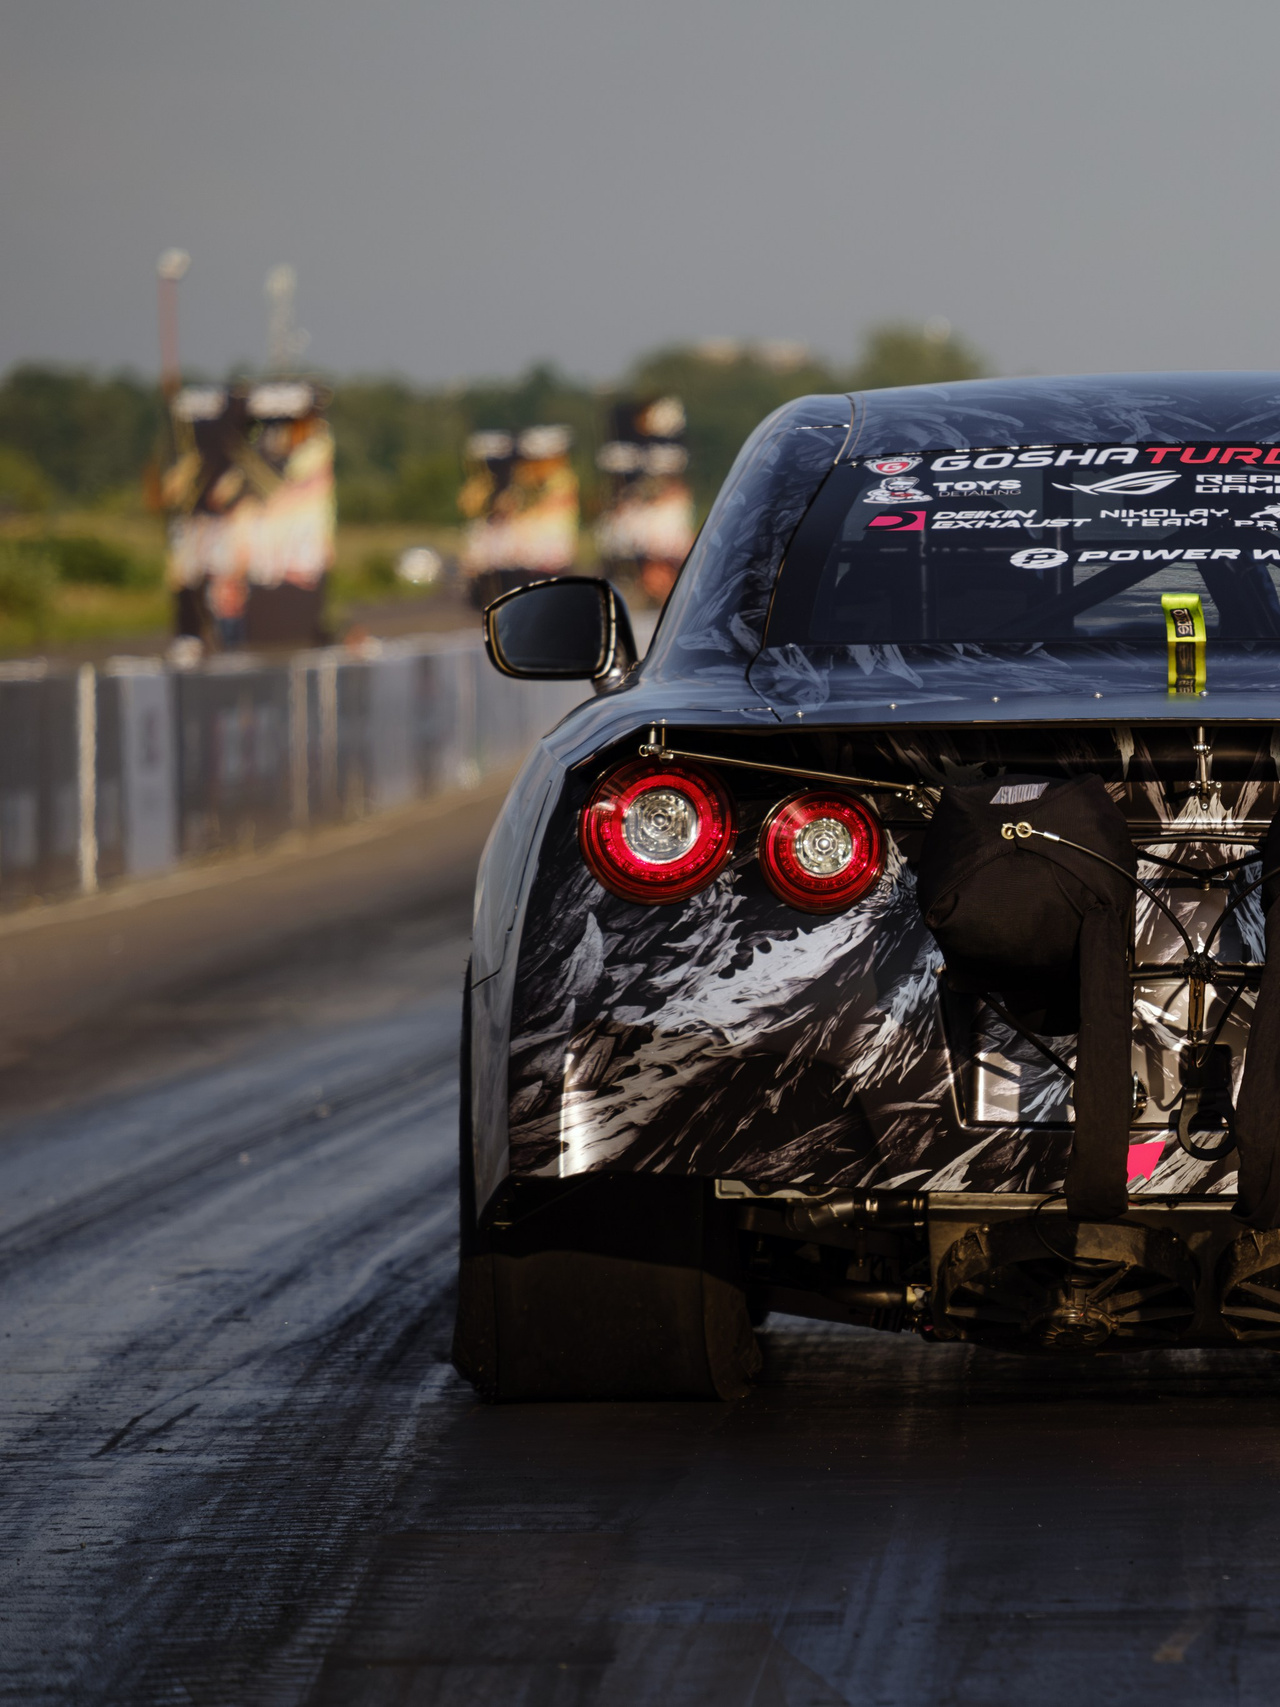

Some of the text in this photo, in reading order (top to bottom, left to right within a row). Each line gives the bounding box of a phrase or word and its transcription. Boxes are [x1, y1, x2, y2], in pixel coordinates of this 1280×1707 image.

[932, 479, 1022, 492] TOYS
[938, 489, 1022, 498] DETAILING
[932, 509, 1037, 520] DEIKIN
[1100, 508, 1230, 518] NIKOLAY
[931, 518, 1092, 530] EXHAUST
[1121, 518, 1208, 527] TEAM
[1078, 549, 1242, 562] POWER
